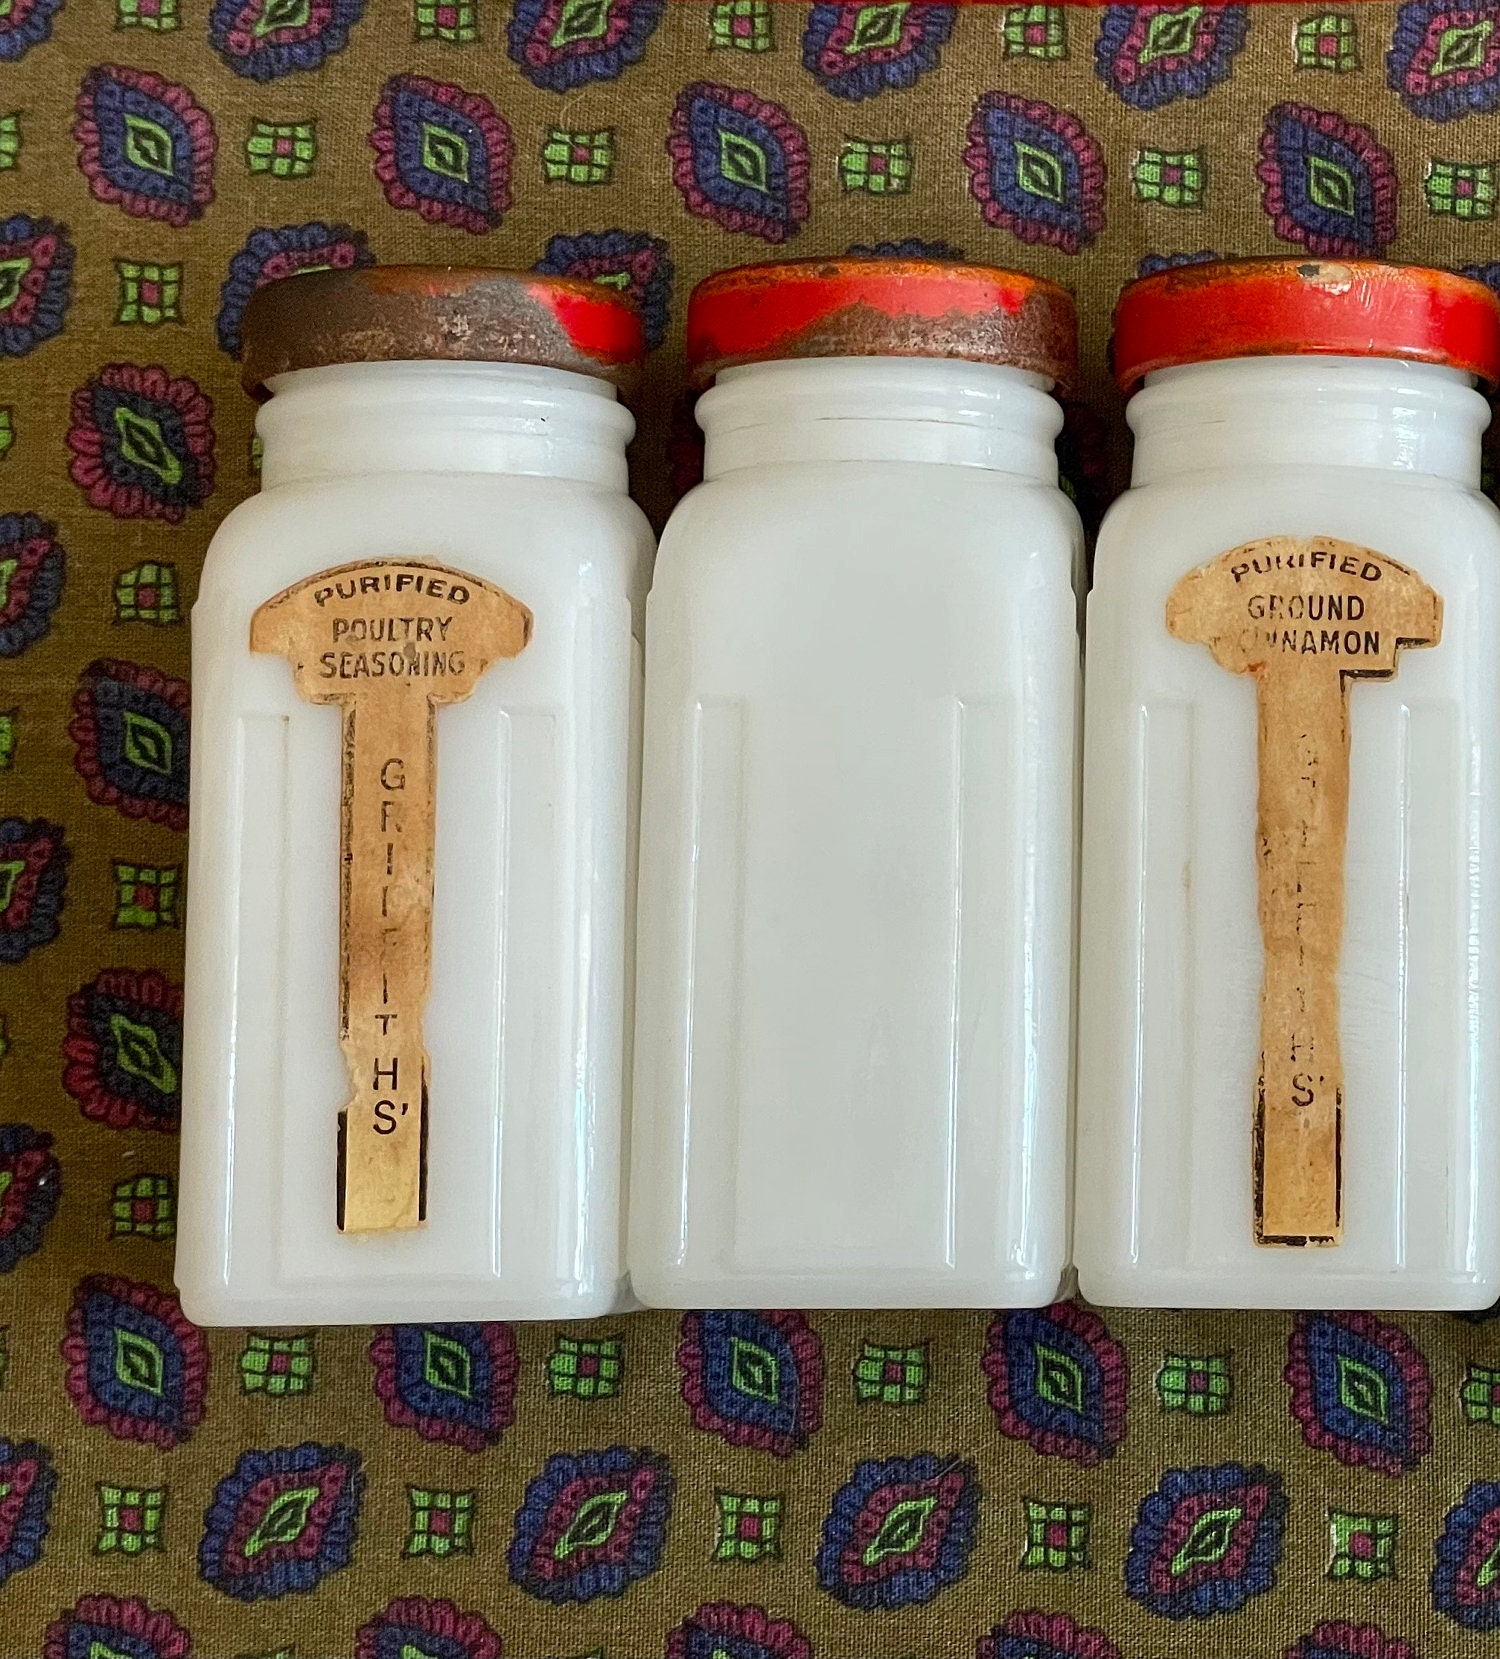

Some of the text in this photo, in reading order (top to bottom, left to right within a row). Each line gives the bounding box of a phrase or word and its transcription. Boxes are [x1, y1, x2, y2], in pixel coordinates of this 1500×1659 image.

[1231, 551, 1382, 583] PURIFIED
[314, 573, 471, 607] PURIFIED
[1248, 594, 1365, 622] GROUND
[332, 616, 453, 643] POULTRY
[319, 651, 465, 679] SEASONING
